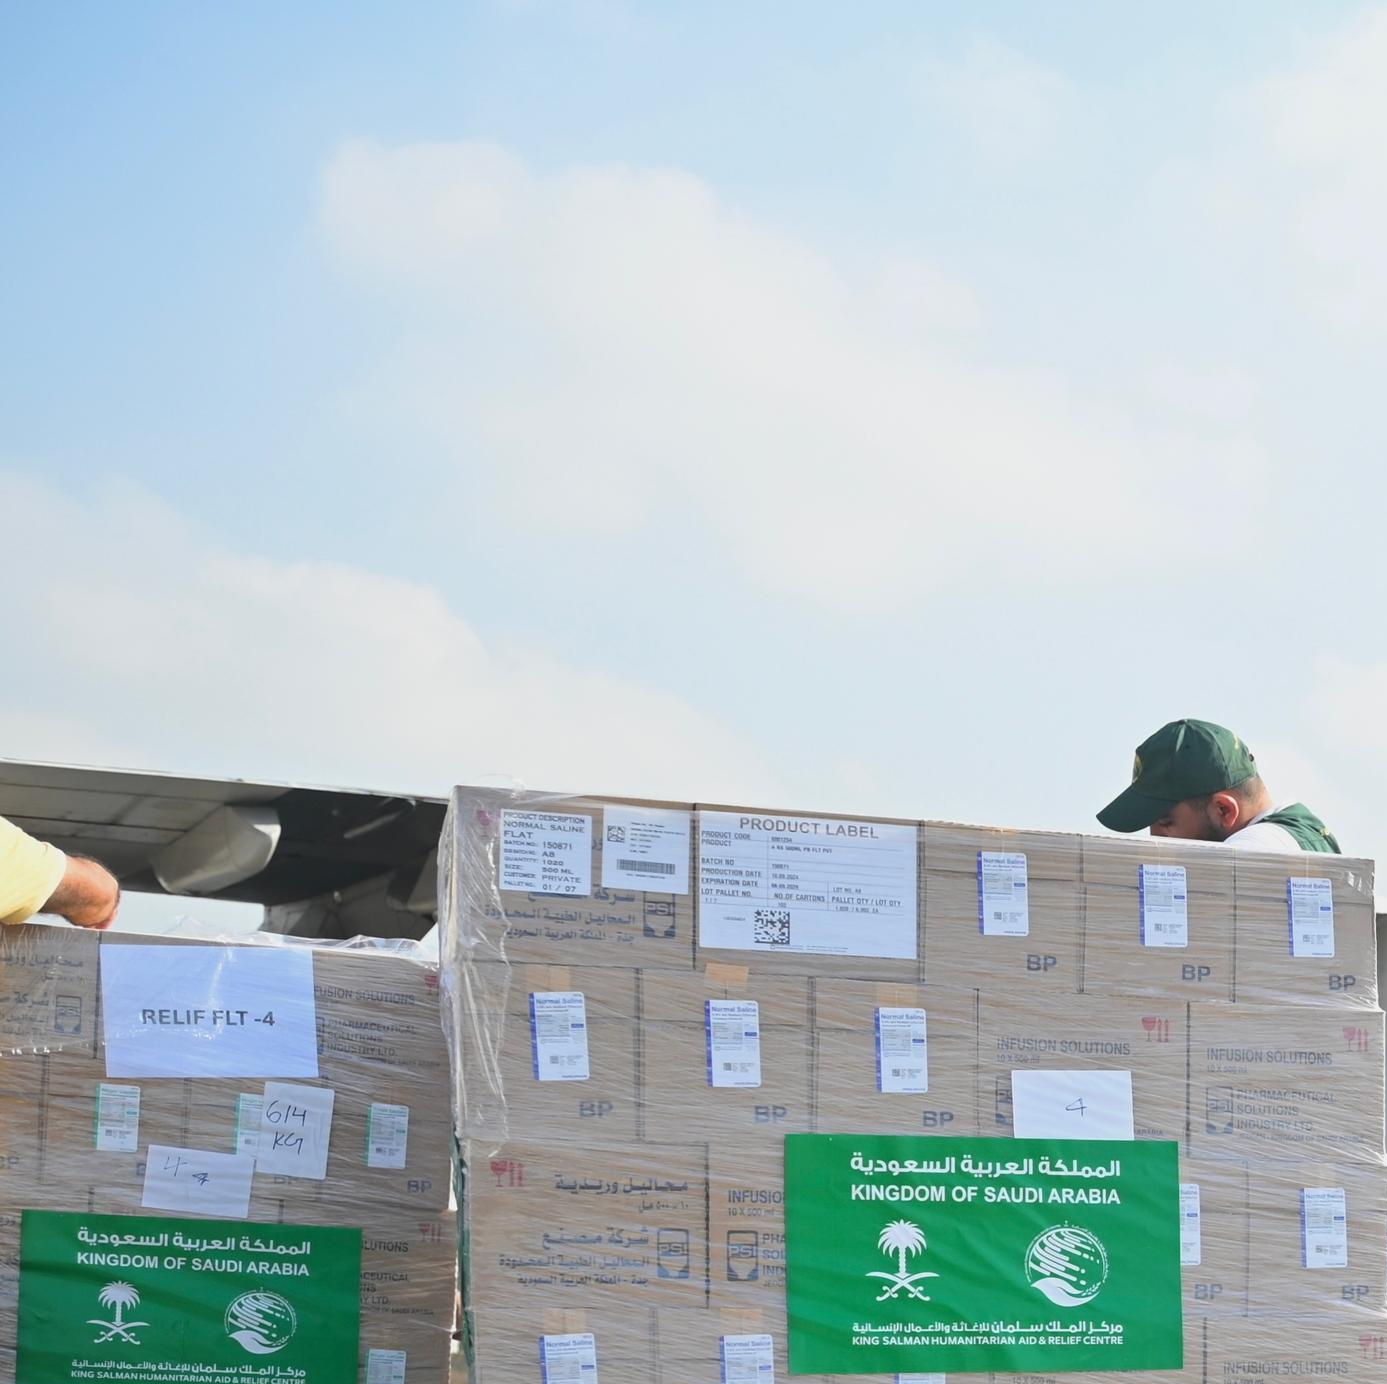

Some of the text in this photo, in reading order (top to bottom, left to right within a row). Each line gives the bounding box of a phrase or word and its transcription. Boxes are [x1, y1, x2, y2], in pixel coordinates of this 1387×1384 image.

[504, 812, 584, 824] PRODUCT DESCRIPTION
[504, 821, 584, 833] NORMAL SALINE
[740, 817, 878, 839] PRODUCT LABEL
[542, 875, 582, 883] PRIVATE
[702, 868, 743, 876] PRODUCTION
[702, 877, 739, 886] EXPIRATION
[1027, 955, 1057, 972] BP
[1182, 965, 1211, 981] BP
[1329, 974, 1357, 991] BP
[142, 1009, 205, 1025] RELIF
[213, 1010, 248, 1026] FLT
[997, 1039, 1130, 1055] INFUSION SOLUTIONS
[1207, 1048, 1332, 1065] INFUSION SOLUTIONS
[266, 1100, 307, 1127] 614
[580, 1101, 613, 1118] BP
[755, 1106, 787, 1123] BP
[1065, 1097, 1087, 1117] 4
[923, 1111, 954, 1128] BP
[273, 1131, 303, 1154] KG
[850, 1153, 1120, 1177] المملكة العربية السعودية
[407, 1179, 432, 1193] BP
[851, 1185, 1120, 1204] KINGDOM OF SAUDI ARABIA
[78, 1227, 310, 1255] المملكة العربية السعودية
[78, 1253, 309, 1276] KINGDOM OF SAUDI ARABIA
[1194, 1284, 1223, 1300] BP
[853, 1336, 1123, 1345] KING SALMAN HUMANITARIAN AID & RELIEF CENTRE
[71, 1371, 94, 1379] KING
[97, 1371, 138, 1380] SALMAN
[140, 1373, 212, 1383] HUMANITARIAN
[215, 1376, 230, 1384] AID
[241, 1377, 269, 1384] RELIEF
